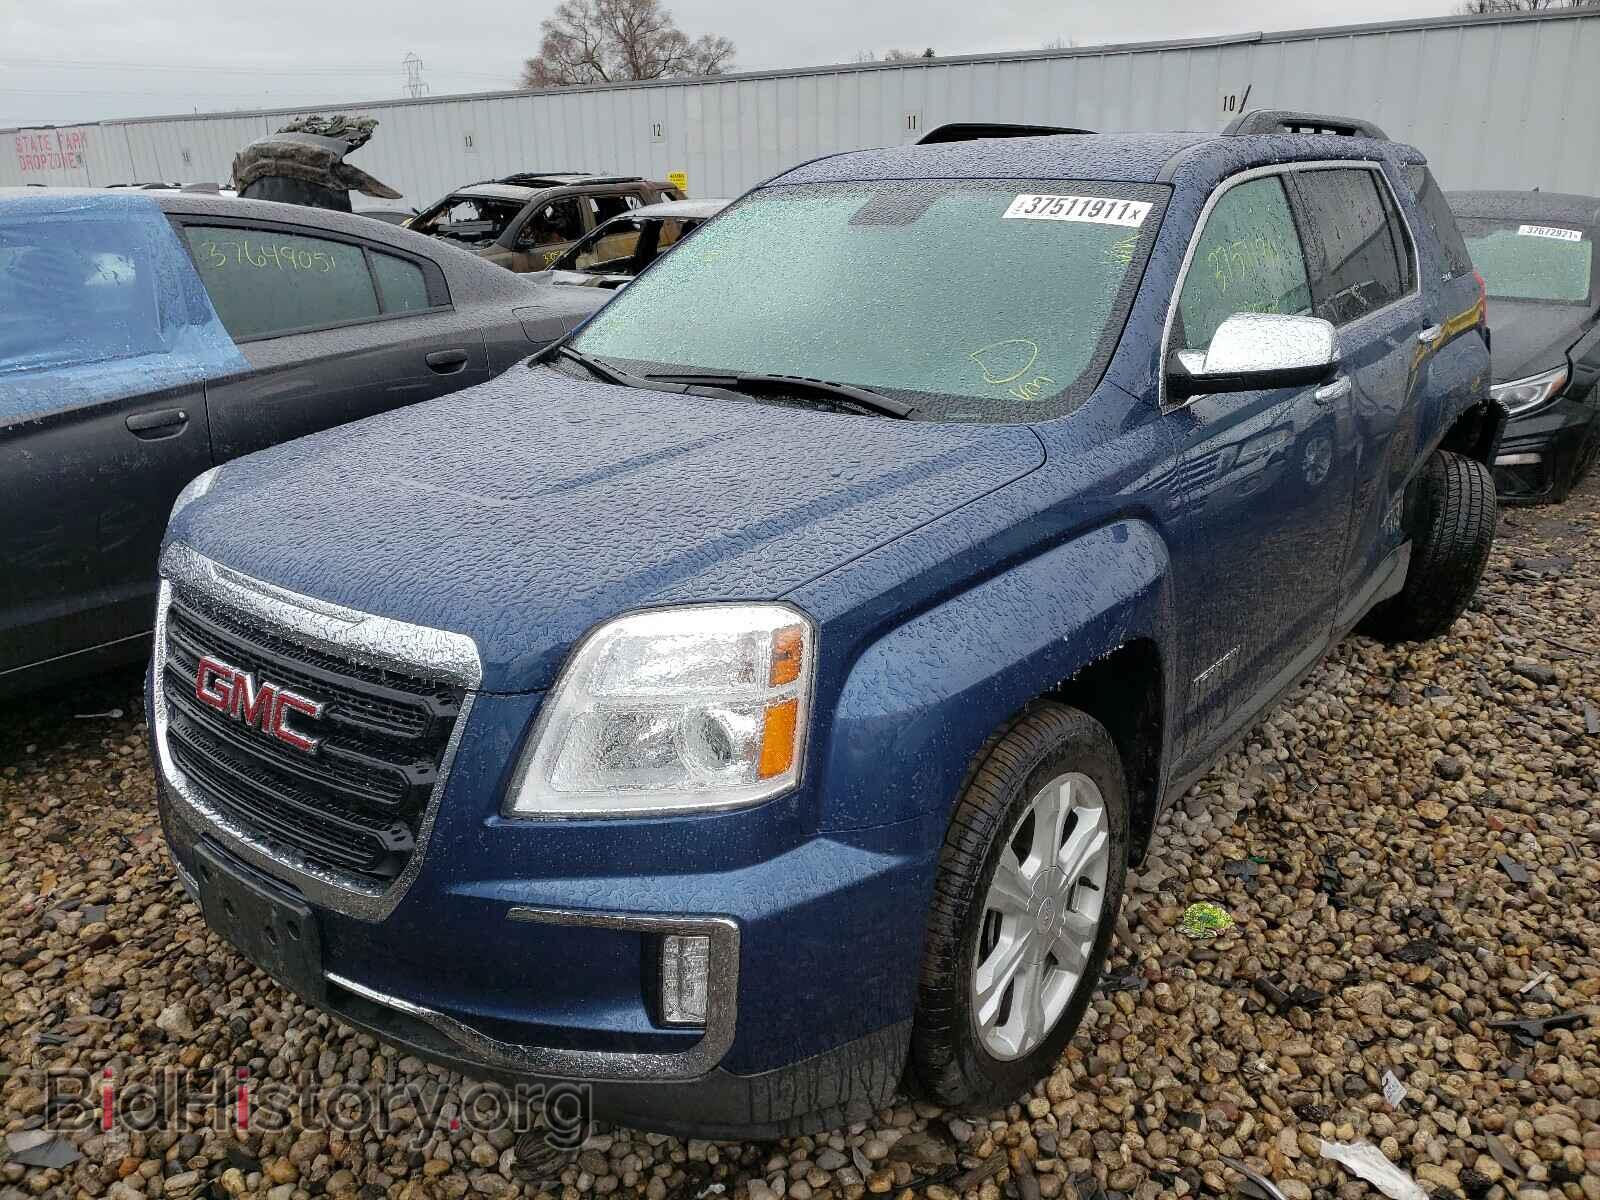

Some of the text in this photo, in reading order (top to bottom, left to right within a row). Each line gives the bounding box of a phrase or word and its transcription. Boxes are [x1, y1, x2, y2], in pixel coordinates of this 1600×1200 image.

[1223, 95, 1236, 112] 10
[652, 123, 662, 137] 12
[907, 114, 917, 130] 11
[16, 134, 51, 152] STATE
[200, 240, 337, 273] 37649051
[196, 655, 322, 754] GMC
